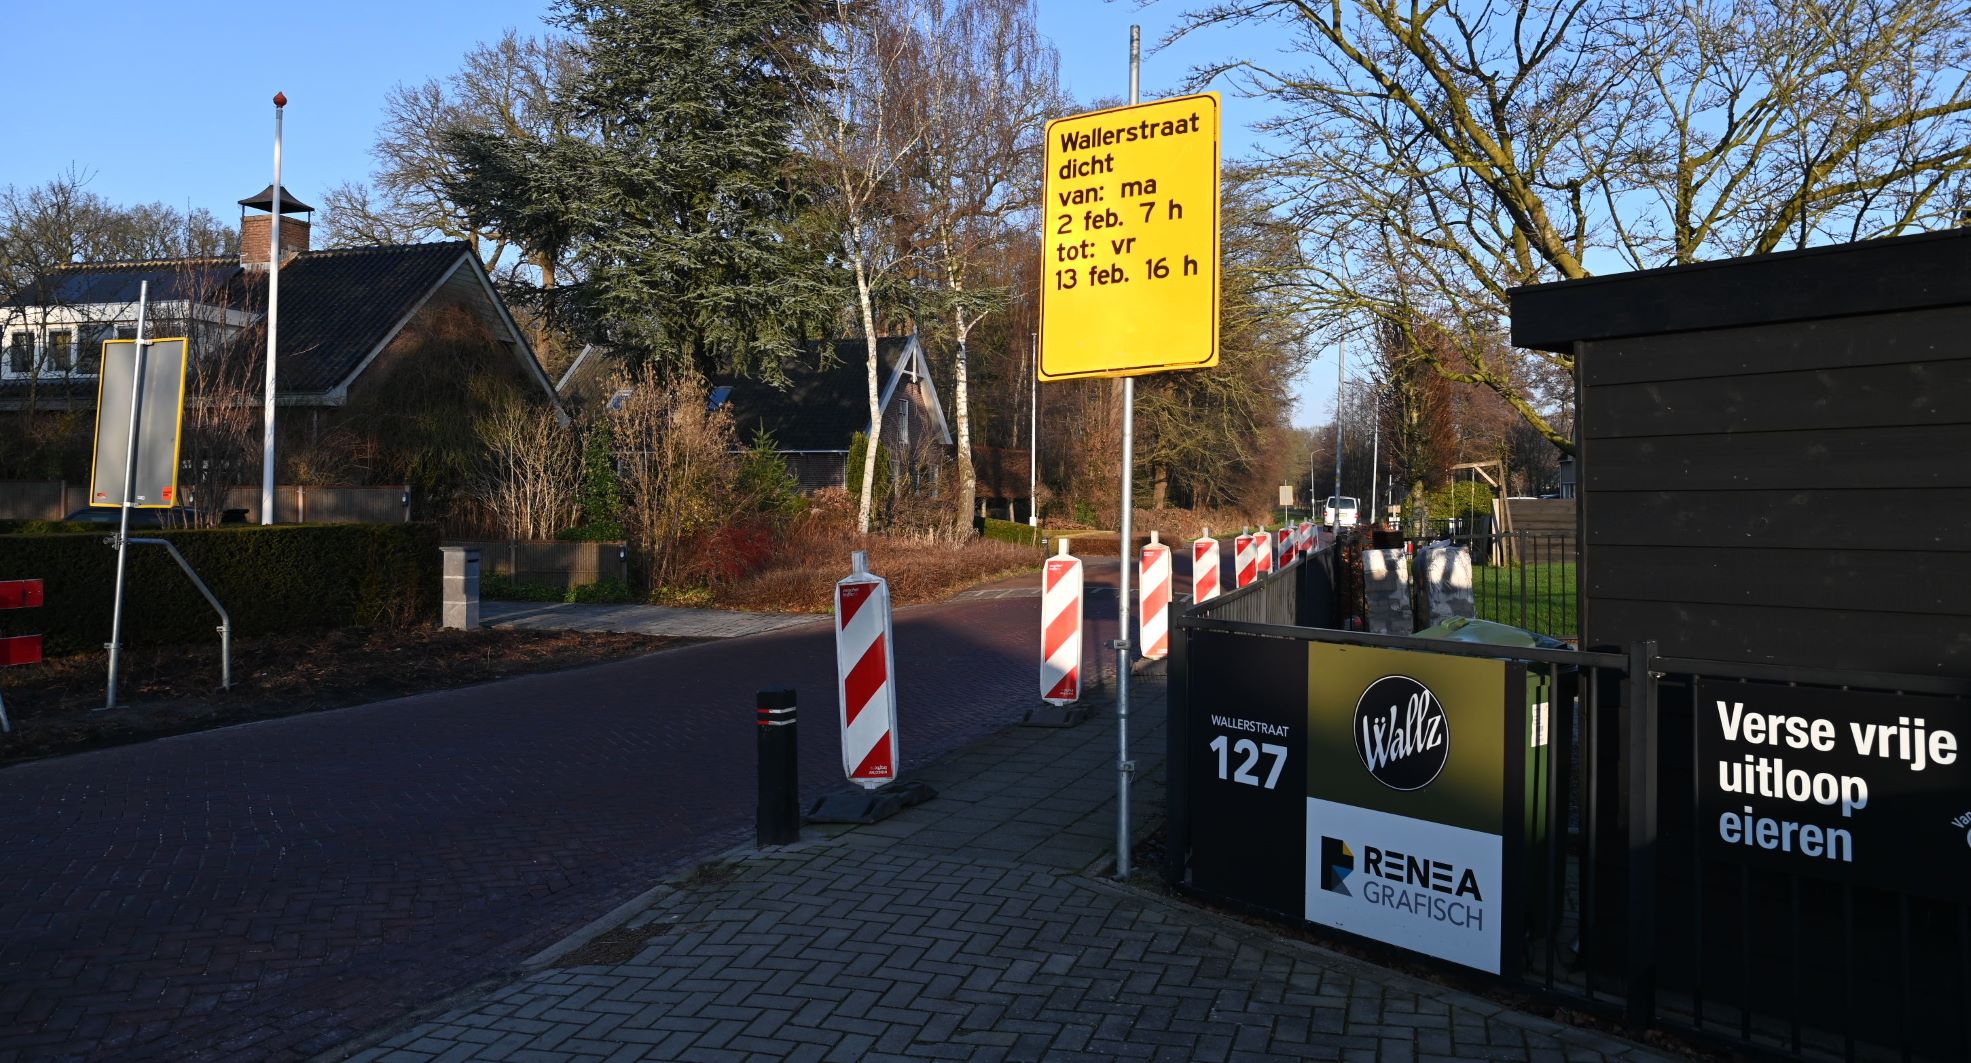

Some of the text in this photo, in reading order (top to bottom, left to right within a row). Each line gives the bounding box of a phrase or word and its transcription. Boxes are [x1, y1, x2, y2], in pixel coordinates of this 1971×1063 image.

[1061, 112, 1199, 153] Wallerstraat
[1059, 153, 1114, 180] dicht
[1059, 179, 1157, 207] van: ma
[1057, 199, 1183, 235] 2 feb. 7 h
[1056, 237, 1136, 262] tot: vr
[1056, 255, 1198, 290] 13 feb. 16 h
[1211, 714, 1290, 738] WALLERSTRAAT
[1717, 701, 1958, 771] Verse vrije
[1209, 735, 1288, 790] 127
[1719, 754, 1868, 818] uitloop
[1719, 805, 1853, 862] eieren
[1364, 845, 1483, 902] RENEA
[1363, 881, 1483, 932] GRAFISCH
